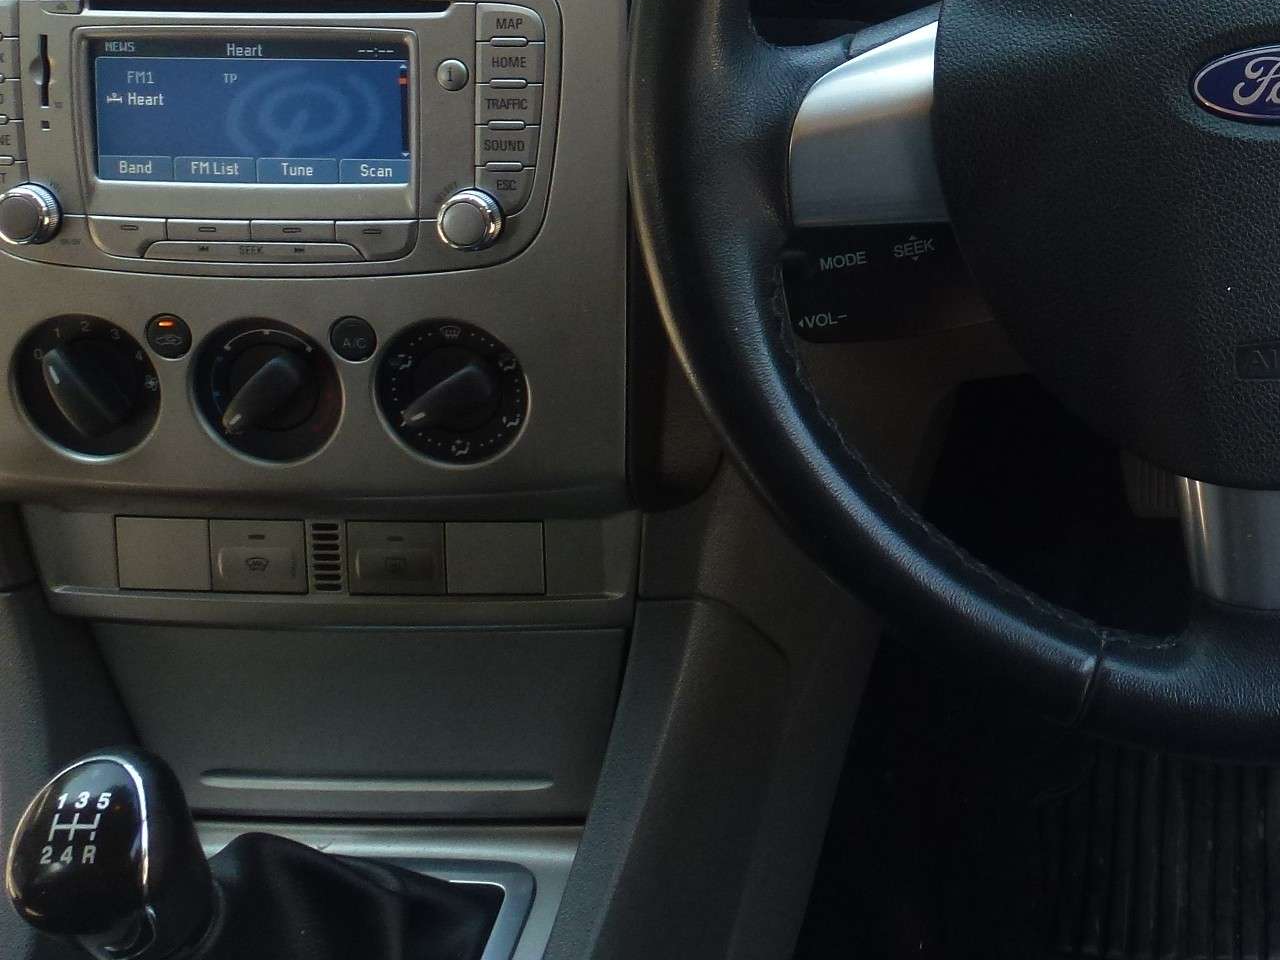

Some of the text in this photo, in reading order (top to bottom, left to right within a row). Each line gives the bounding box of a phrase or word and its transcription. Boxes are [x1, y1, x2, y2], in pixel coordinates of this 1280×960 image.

[495, 18, 524, 30] MAP
[104, 41, 136, 52] NEWS
[226, 43, 263, 57] Heart
[491, 56, 527, 69] HOME
[127, 71, 155, 84] FM1
[223, 73, 238, 84] TP
[127, 92, 165, 106] Heart
[484, 98, 528, 111] TRAFFIC
[483, 139, 525, 152] SOUND
[119, 160, 153, 174] Band
[191, 161, 240, 175] FM List
[281, 162, 314, 176] Tune
[360, 163, 393, 177] Scan
[496, 179, 517, 191] ESC
[893, 237, 936, 258] SEEK
[819, 251, 868, 272] MODE
[80, 320, 90, 332] 2
[110, 328, 121, 340] 3
[57, 791, 112, 810] 1 3 5
[40, 844, 97, 865] 2 4 R
